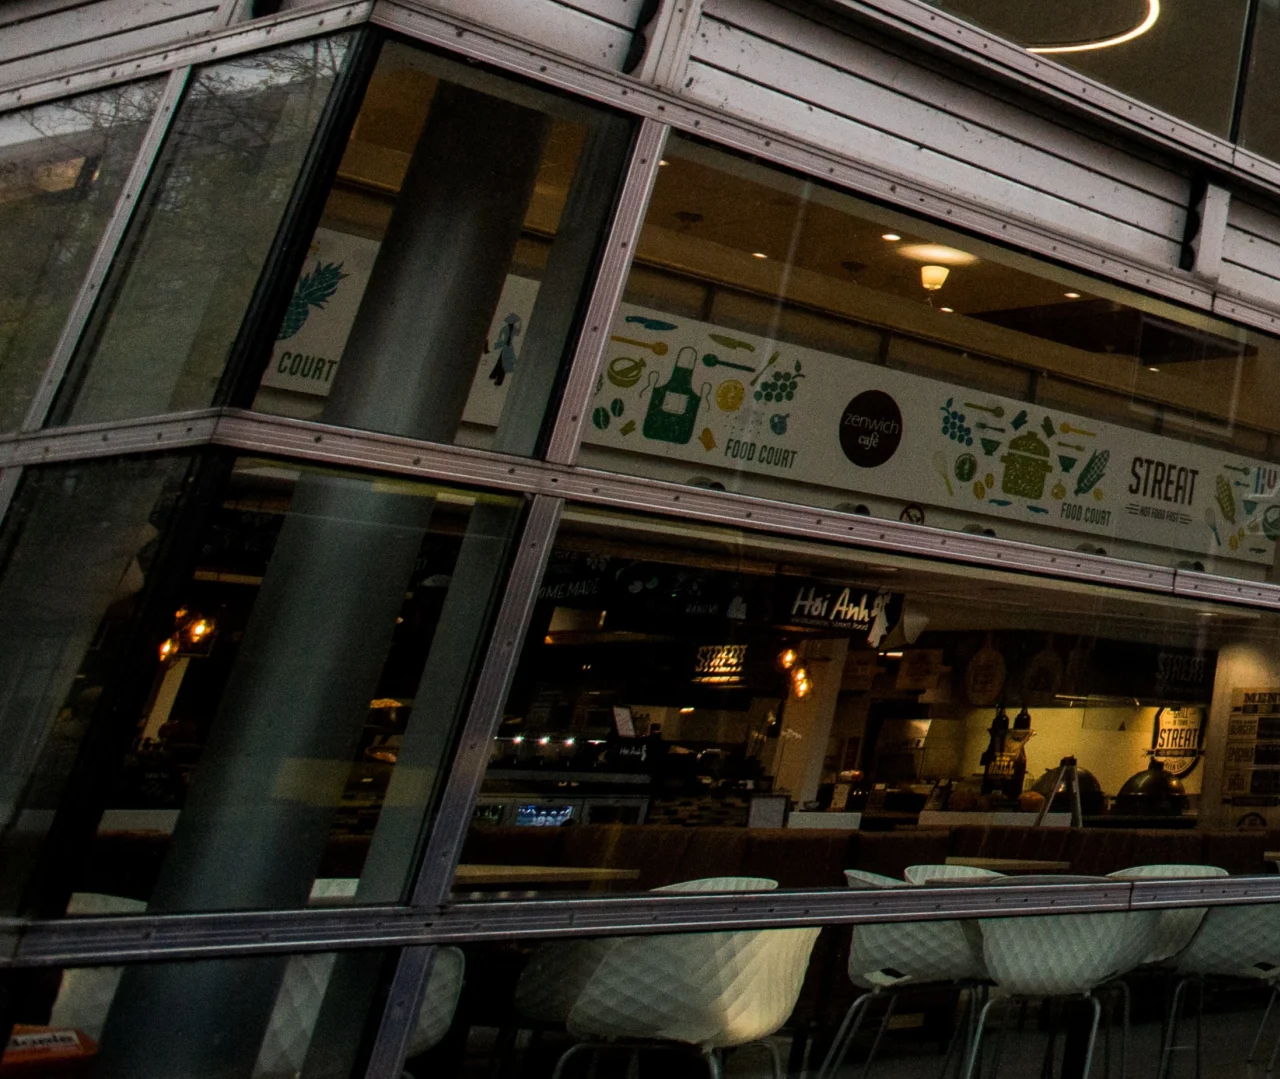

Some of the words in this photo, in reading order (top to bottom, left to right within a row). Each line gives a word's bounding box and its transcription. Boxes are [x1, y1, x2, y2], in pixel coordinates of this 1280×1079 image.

[277, 351, 338, 382] COURT
[843, 412, 899, 435] zenwich
[724, 438, 756, 461] FOOD
[758, 444, 798, 469] COURT
[1129, 457, 1199, 506] STREAT
[1061, 502, 1083, 521] FOOD
[1084, 506, 1112, 527] COURT
[538, 585, 565, 600] OME
[829, 587, 870, 622] Anh
[1159, 728, 1198, 748] STREAT
